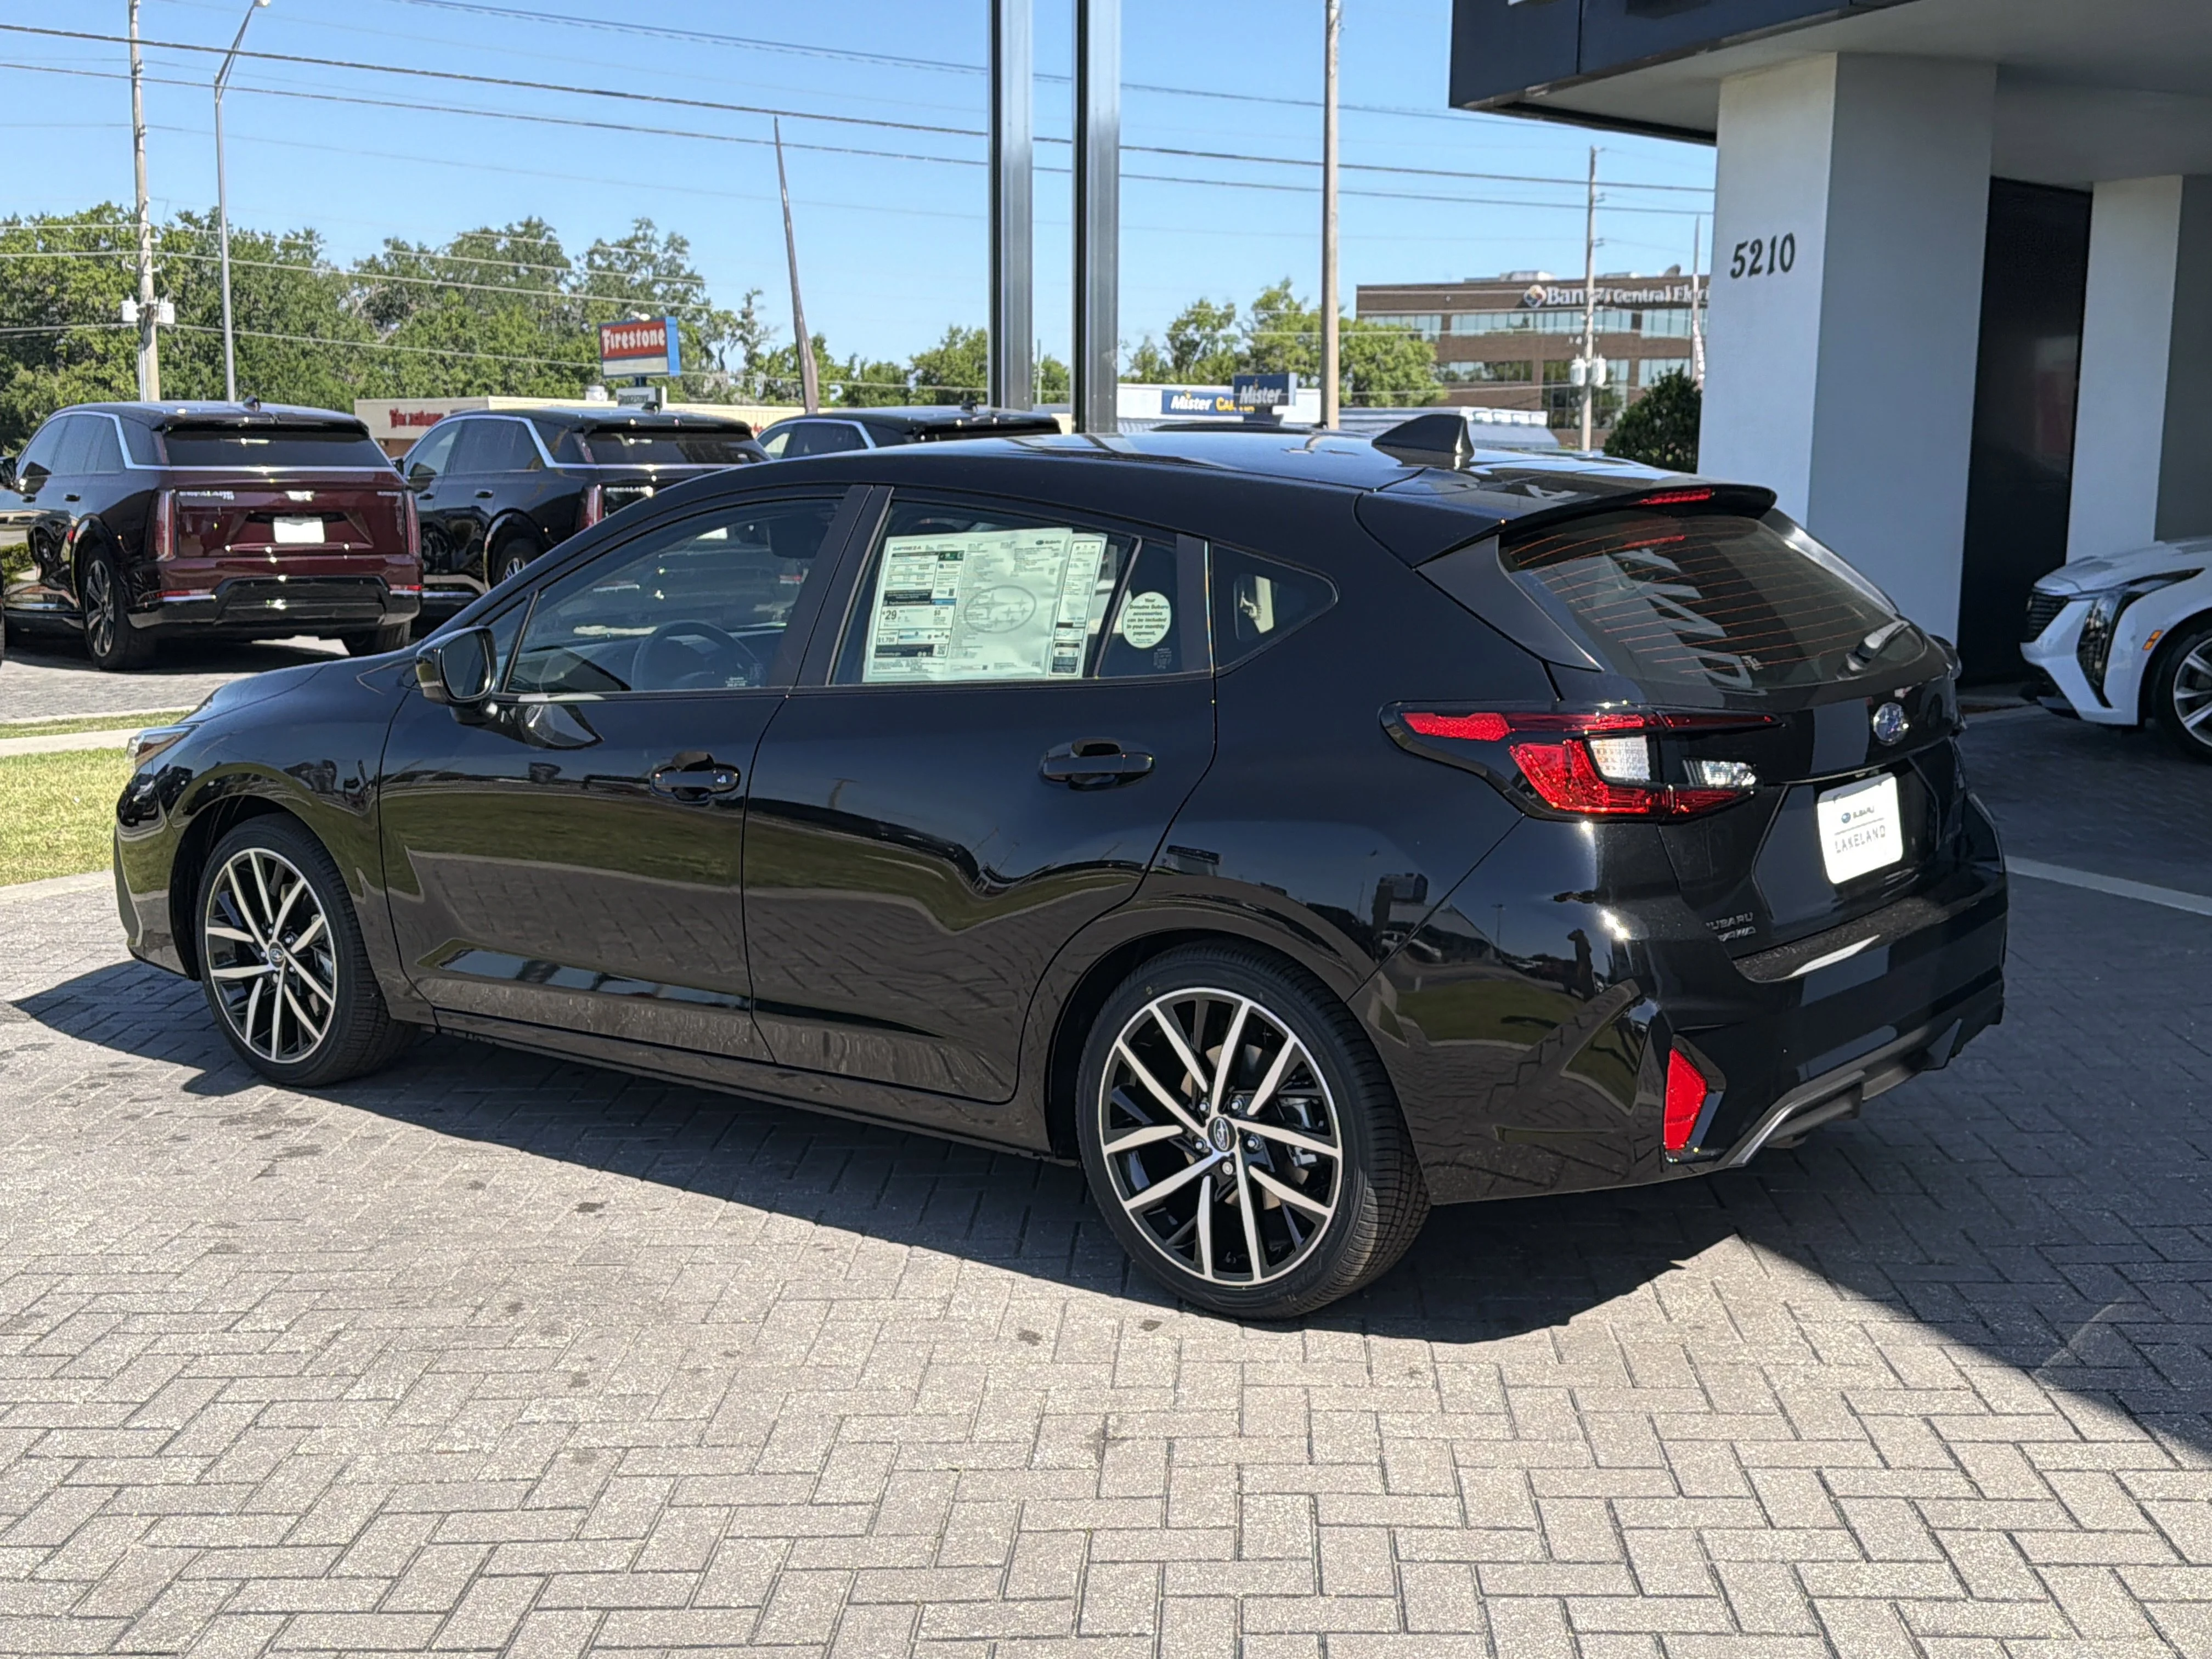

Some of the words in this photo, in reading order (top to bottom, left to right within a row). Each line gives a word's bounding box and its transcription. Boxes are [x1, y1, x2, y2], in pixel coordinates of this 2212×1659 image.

[1730, 232, 1796, 279] 5210
[1613, 285, 1671, 303] Central
[602, 328, 665, 354] Firestone
[1170, 394, 1213, 411] Mister
[1239, 384, 1283, 404] Mister
[885, 610, 896, 620] 29
[1853, 806, 1875, 819] SUBARU
[1835, 825, 1886, 854] LAKELAND
